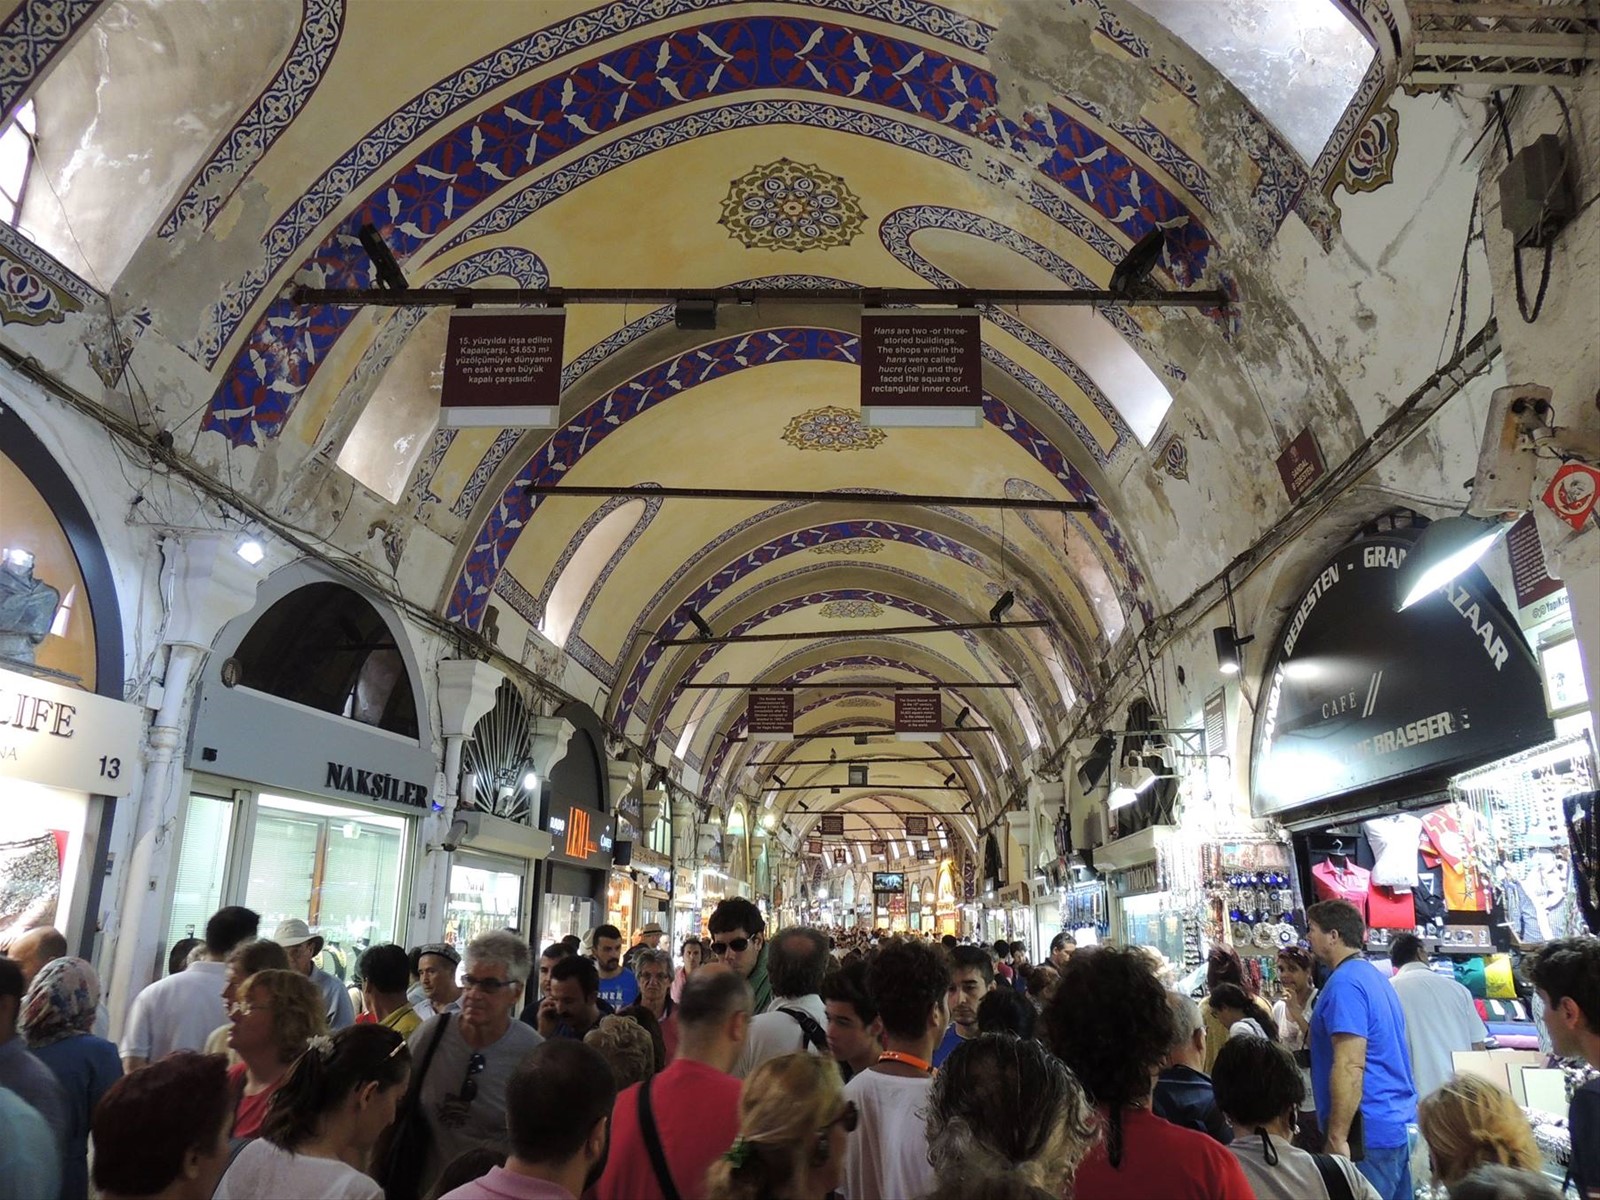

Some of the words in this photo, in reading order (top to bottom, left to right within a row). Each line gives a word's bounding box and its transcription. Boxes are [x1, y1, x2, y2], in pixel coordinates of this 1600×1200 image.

[873, 327, 895, 335] Hans
[459, 337, 471, 345] 15.
[472, 337, 506, 348] yüzyılda
[527, 336, 552, 344] edilen
[884, 336, 914, 344] storied
[915, 336, 957, 346] buildings.
[876, 346, 894, 354] The
[894, 346, 921, 355] shops
[922, 346, 949, 354] within
[950, 346, 964, 354] the
[886, 356, 906, 364] hans
[930, 356, 956, 364] called
[474, 366, 492, 374] eski
[505, 366, 516, 374] en
[518, 366, 544, 374] büyük
[904, 366, 926, 374] (cell)
[945, 366, 964, 374] they
[920, 376, 951, 384] square
[871, 385, 920, 395] rectangular
[922, 385, 944, 393] inner
[945, 385, 972, 393] court.
[1283, 562, 1340, 658] BEDESTEN
[1364, 546, 1407, 569] GRAN
[1439, 580, 1509, 672] AZAAR
[1321, 687, 1358, 720] CAFÉ
[98, 755, 121, 780] 13
[324, 761, 428, 808] NAKŞİLER
